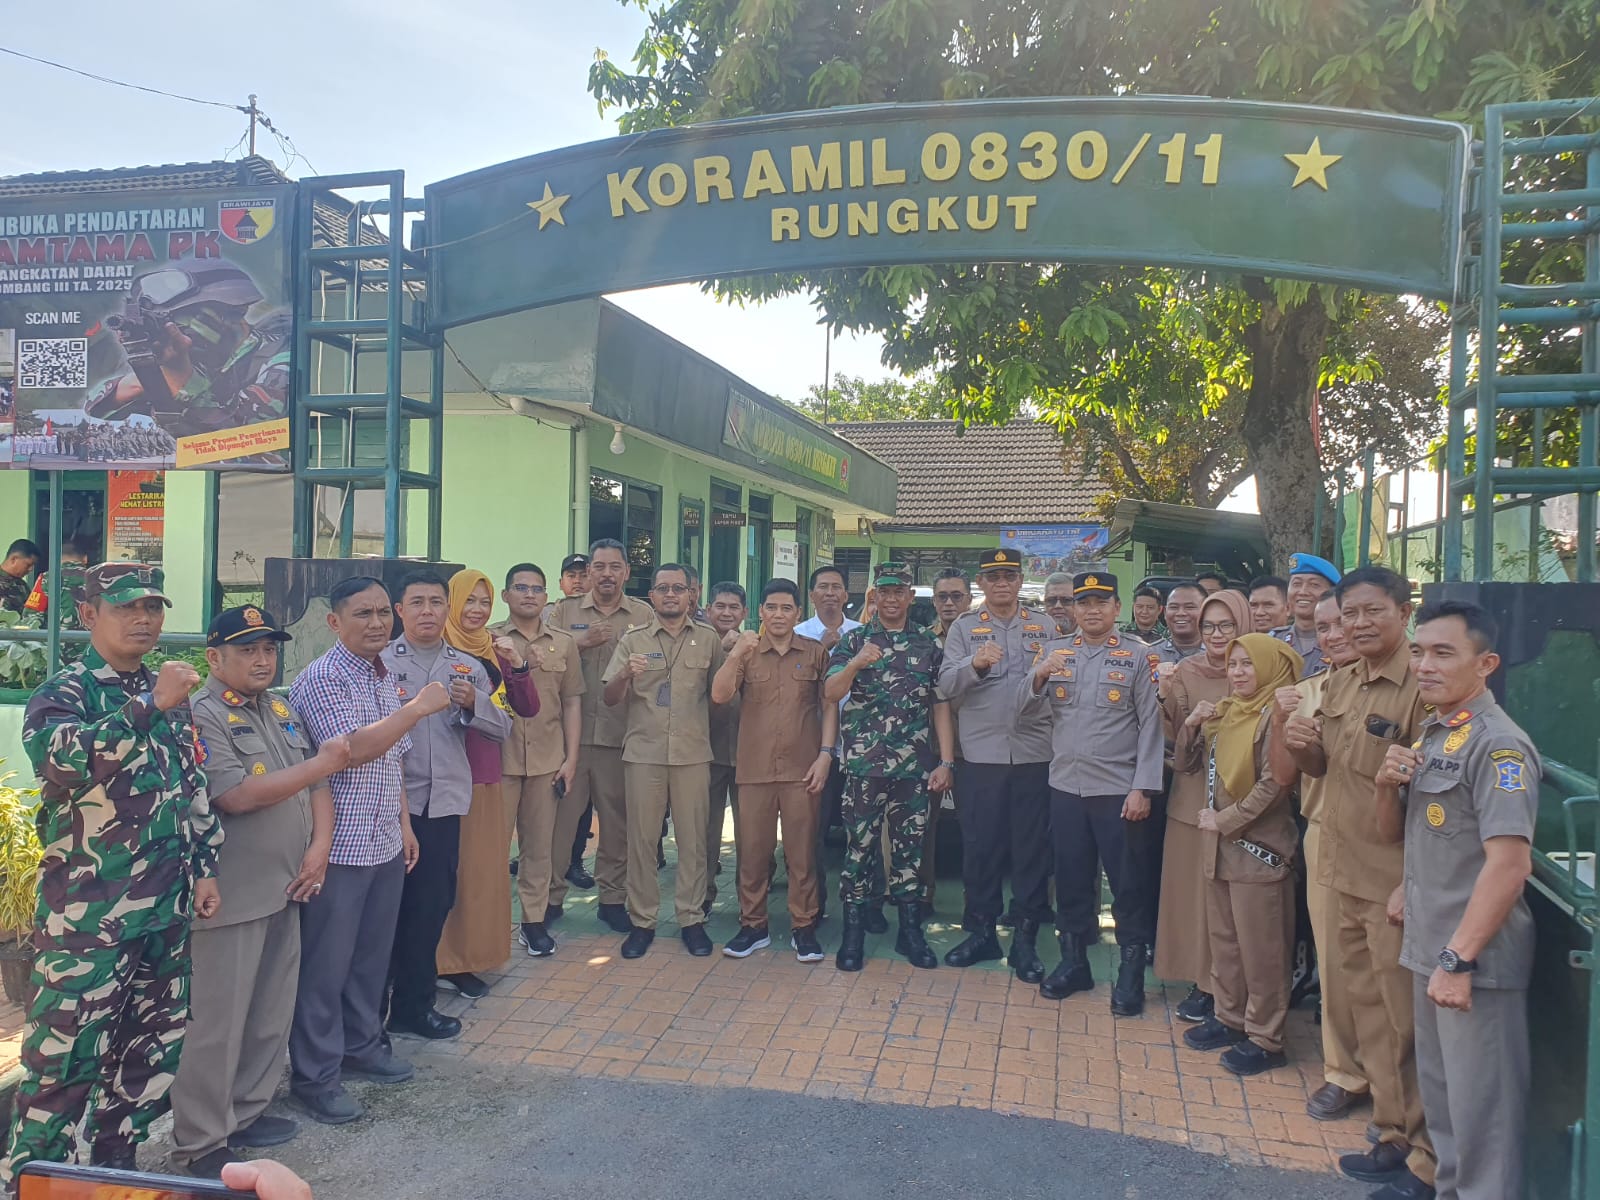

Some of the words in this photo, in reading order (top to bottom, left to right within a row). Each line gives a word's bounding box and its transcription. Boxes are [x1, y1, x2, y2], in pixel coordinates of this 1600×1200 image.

[607, 138, 906, 217] KORAMIL
[920, 130, 1223, 185] 0830/11
[223, 200, 272, 209] BRAWIJAYA
[64, 207, 206, 234] PENDAFTARAN
[771, 194, 1037, 242] RUNGKUT
[168, 230, 223, 260] PK
[0, 266, 80, 282] ANGKATAN
[83, 264, 135, 279] DARAT
[54, 281, 70, 293] III
[72, 281, 93, 293] TA.
[96, 279, 133, 292] 2025
[25, 311, 59, 325] SCAN
[61, 311, 81, 325] ME
[1104, 659, 1134, 668] POLRI
[1429, 757, 1445, 771] POL
[1445, 762, 1460, 772] PP
